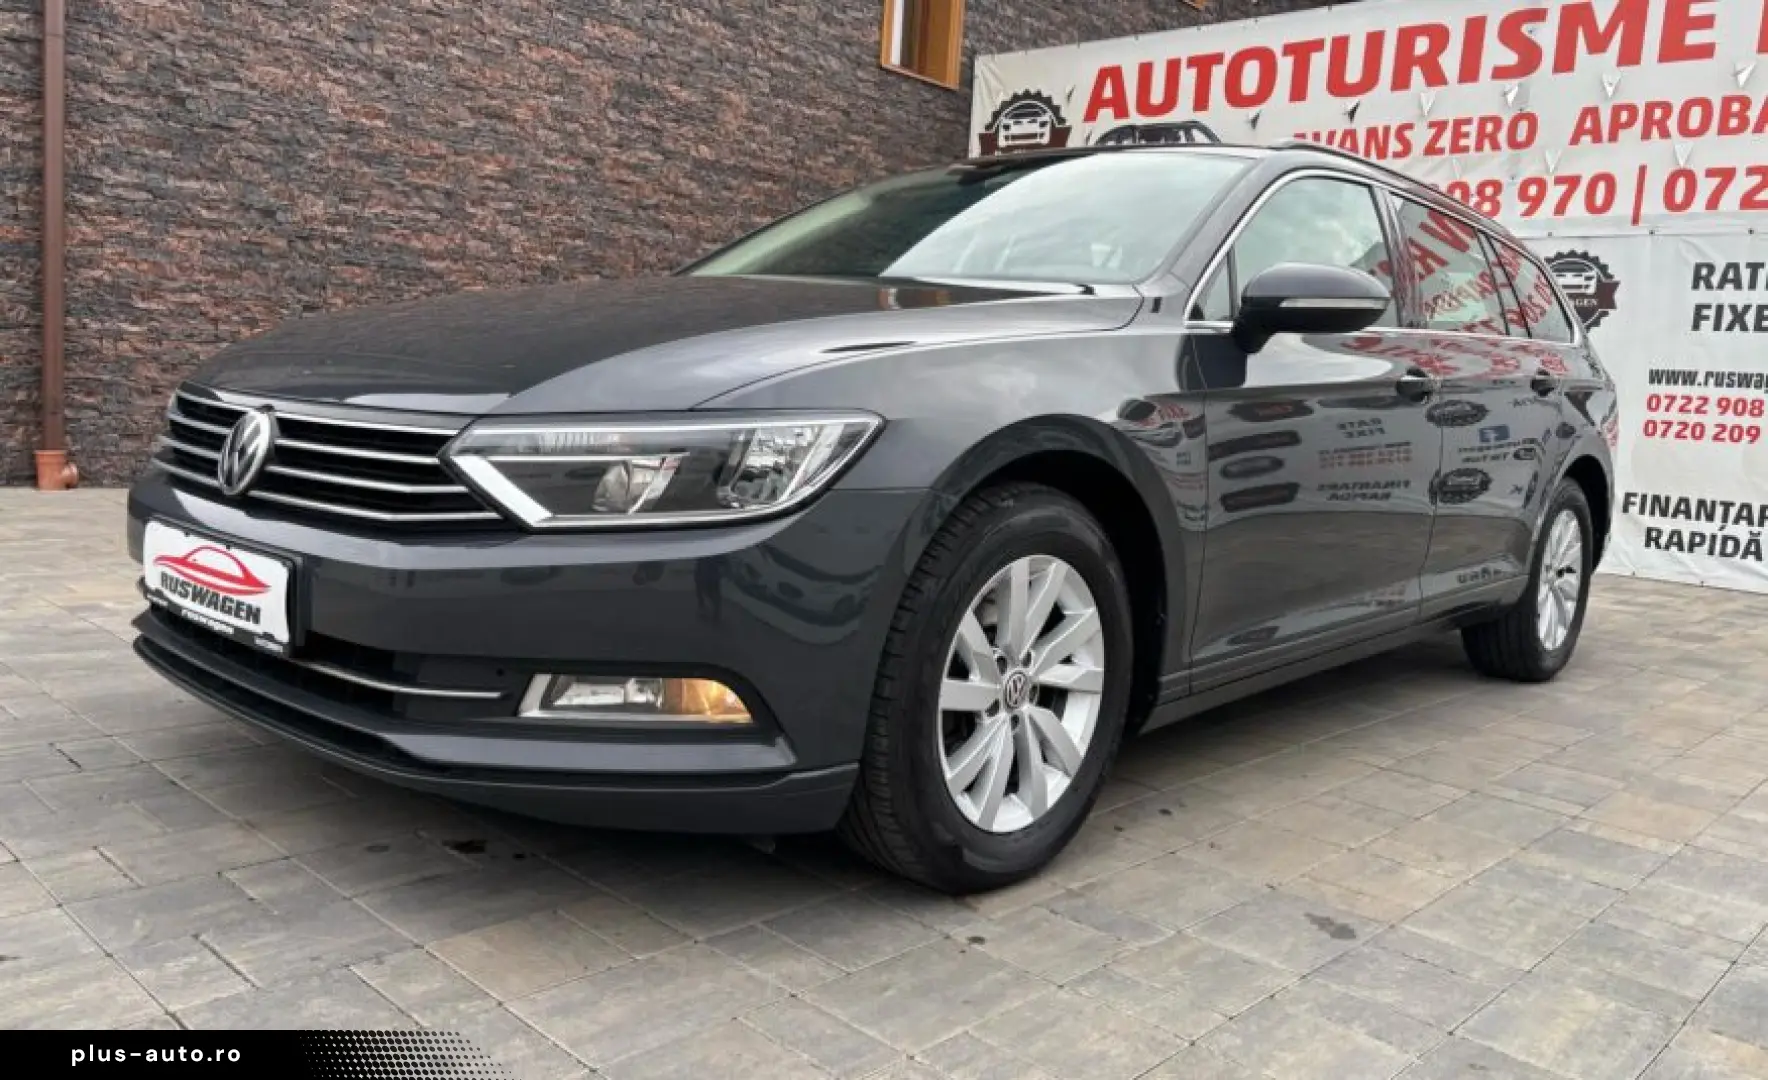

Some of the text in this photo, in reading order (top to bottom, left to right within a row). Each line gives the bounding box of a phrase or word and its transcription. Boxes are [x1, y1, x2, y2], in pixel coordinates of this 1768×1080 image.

[1083, 0, 1717, 123] AUTOTURISME
[1294, 123, 1414, 161] ANS
[1423, 112, 1539, 157] ZERO
[1432, 179, 1504, 219] 08
[1517, 171, 1617, 217] 970
[1663, 165, 1768, 213] 072
[1691, 262, 1768, 291] RAT
[1691, 303, 1768, 333] FIXE
[1647, 394, 1765, 417] 0722 908
[1644, 419, 1761, 444] 0720 209
[1644, 526, 1763, 562] RAPIDĂ
[160, 571, 262, 625] RUSWAGEN
